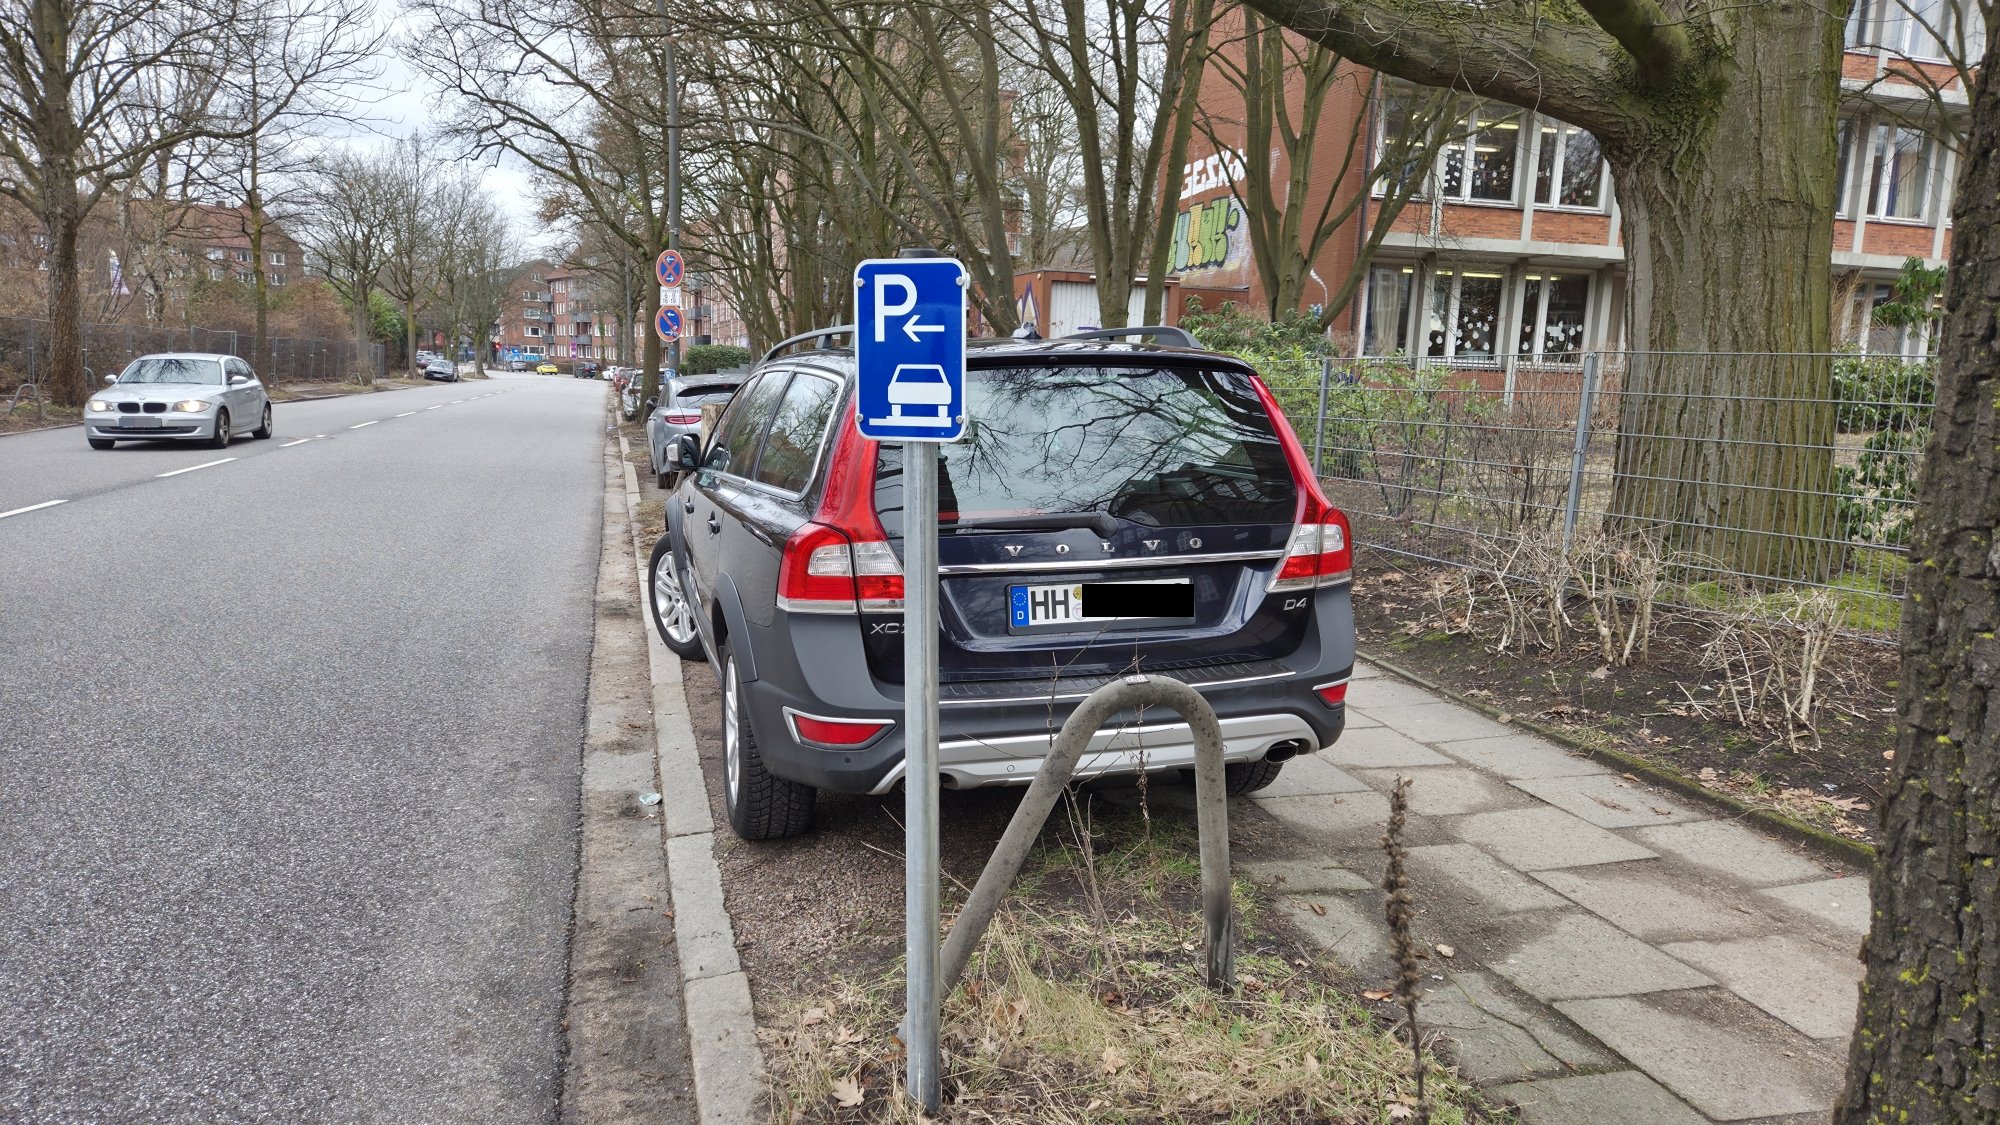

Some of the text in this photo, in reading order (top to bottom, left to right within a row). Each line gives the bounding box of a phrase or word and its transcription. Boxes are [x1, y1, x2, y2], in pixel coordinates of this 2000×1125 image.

[874, 274, 918, 343] P
[1004, 538, 1203, 557] VOLVO
[1017, 589, 1070, 620] D HH
[1284, 597, 1307, 611] D4
[870, 622, 905, 635] XC
